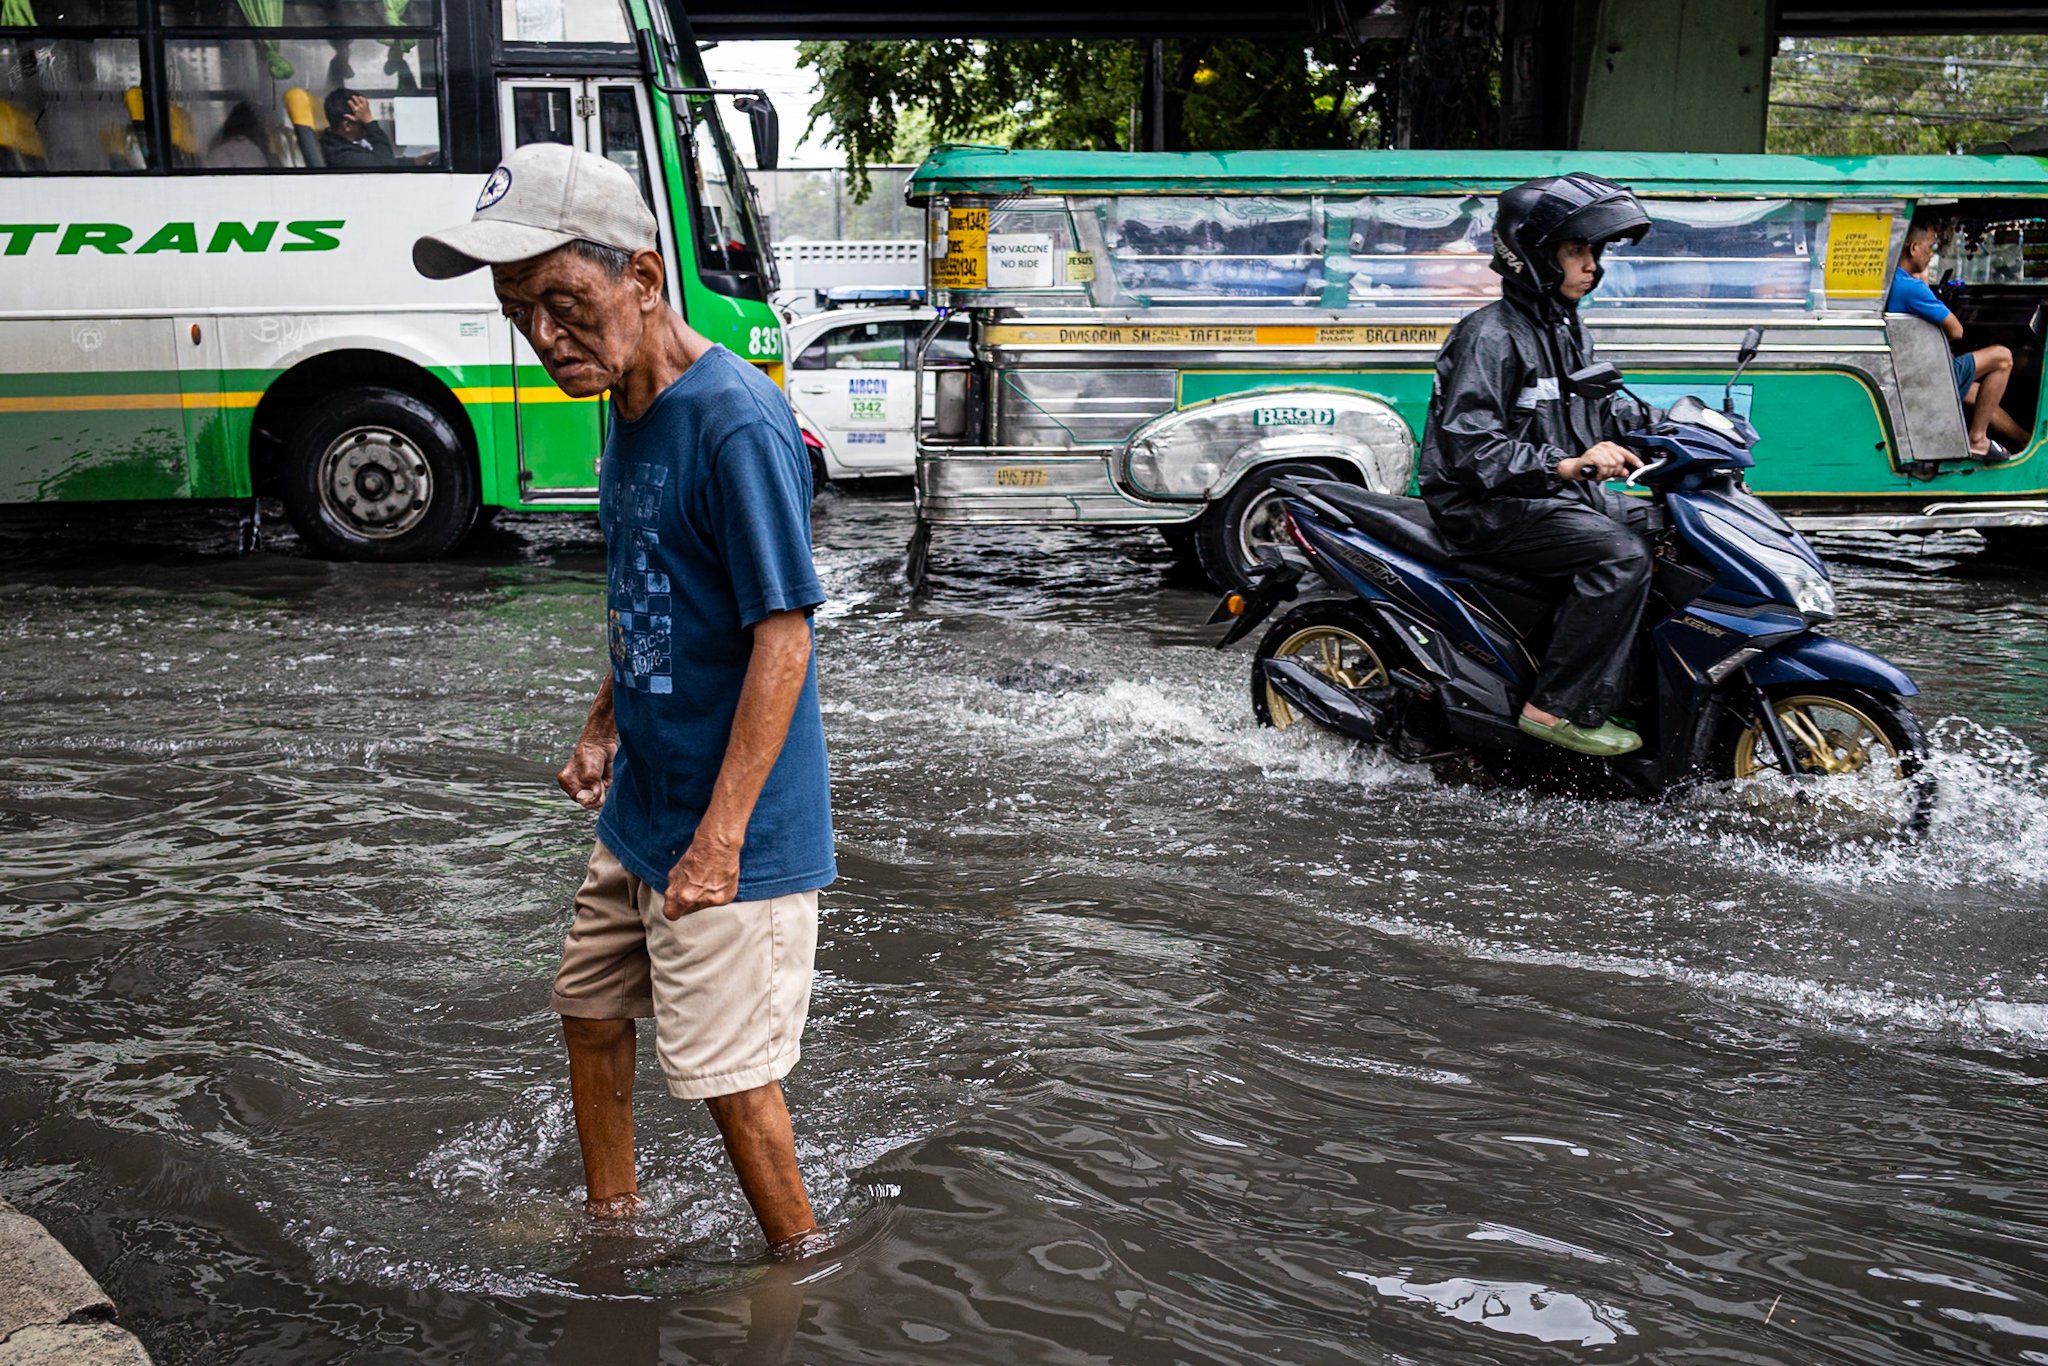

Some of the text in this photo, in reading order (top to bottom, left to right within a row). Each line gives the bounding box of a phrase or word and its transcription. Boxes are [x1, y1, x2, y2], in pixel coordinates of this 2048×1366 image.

[0, 219, 346, 256] TRANS
[991, 245, 1048, 254] NO VACCINE
[1001, 260, 1039, 268] NO RIDE
[1067, 257, 1093, 265] JESUS
[1060, 329, 1121, 343] DIVISORIA
[1132, 329, 1150, 343] SM
[1189, 329, 1221, 342] TAFT
[1366, 329, 1437, 343] BACLARAN
[849, 379, 887, 394] AIRCON
[853, 402, 881, 412] 1342
[1257, 409, 1332, 425] BROD
